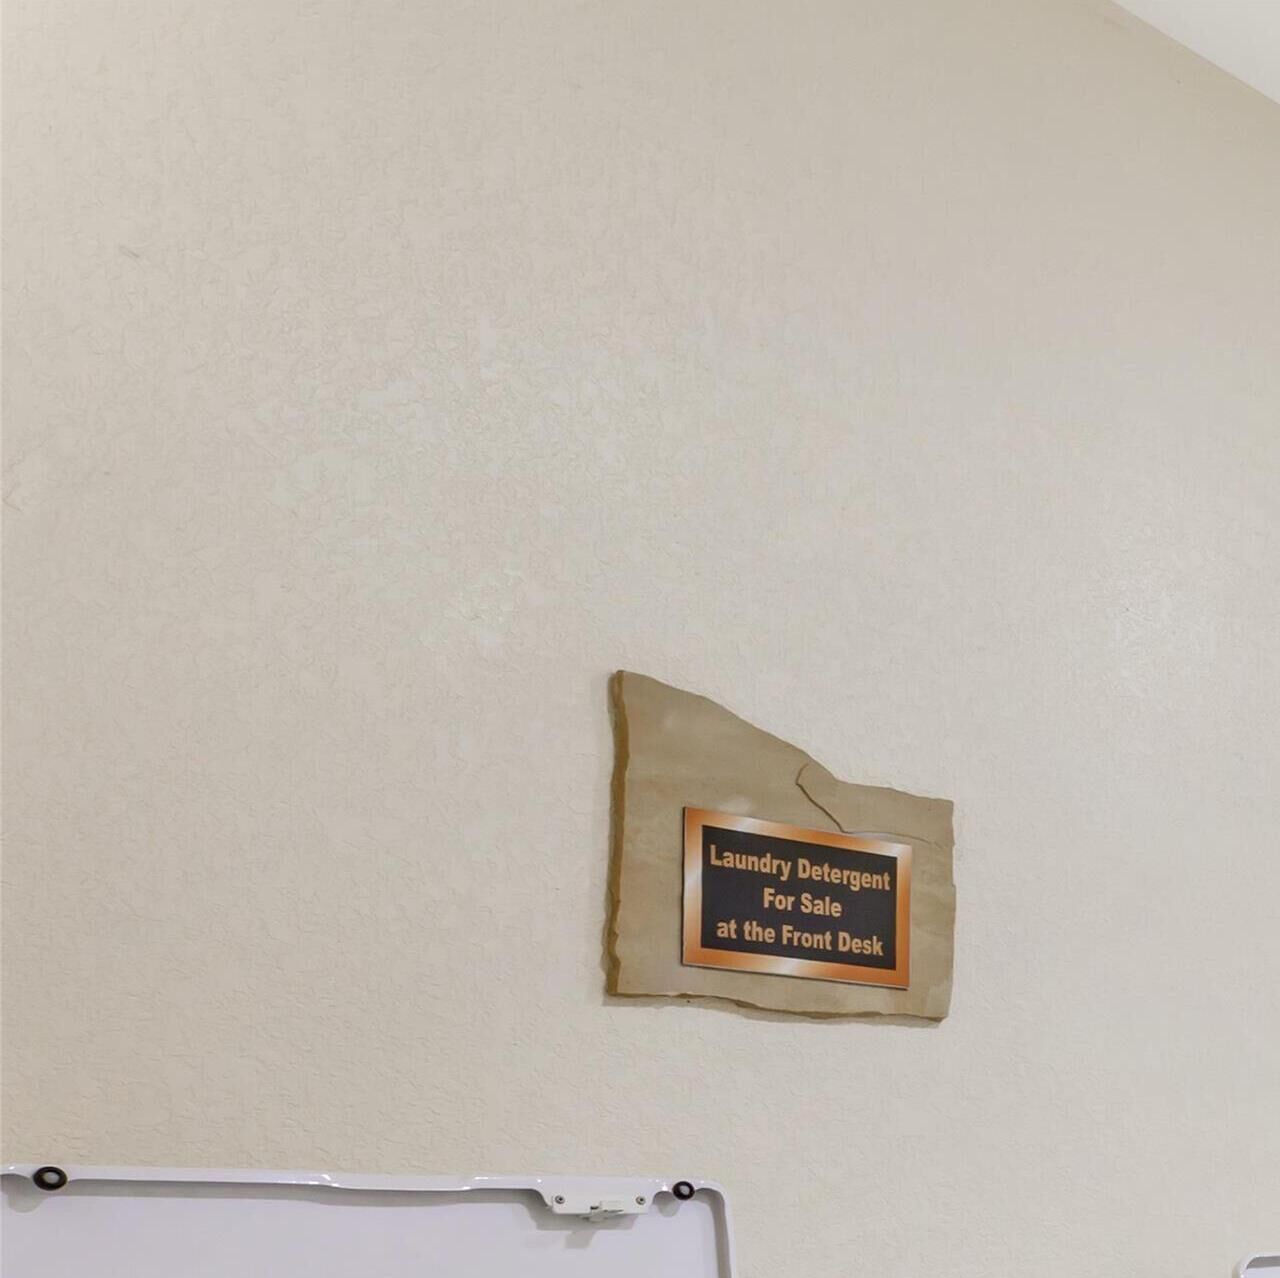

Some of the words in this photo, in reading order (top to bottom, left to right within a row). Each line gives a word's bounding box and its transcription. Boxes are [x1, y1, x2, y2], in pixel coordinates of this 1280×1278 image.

[710, 844, 792, 882] Laundry
[797, 858, 891, 892] Detergent
[762, 887, 796, 912] For
[800, 892, 843, 918] Sale
[716, 919, 738, 940] at
[743, 920, 776, 943] the
[781, 924, 833, 951] Front
[838, 932, 884, 957] Desk
